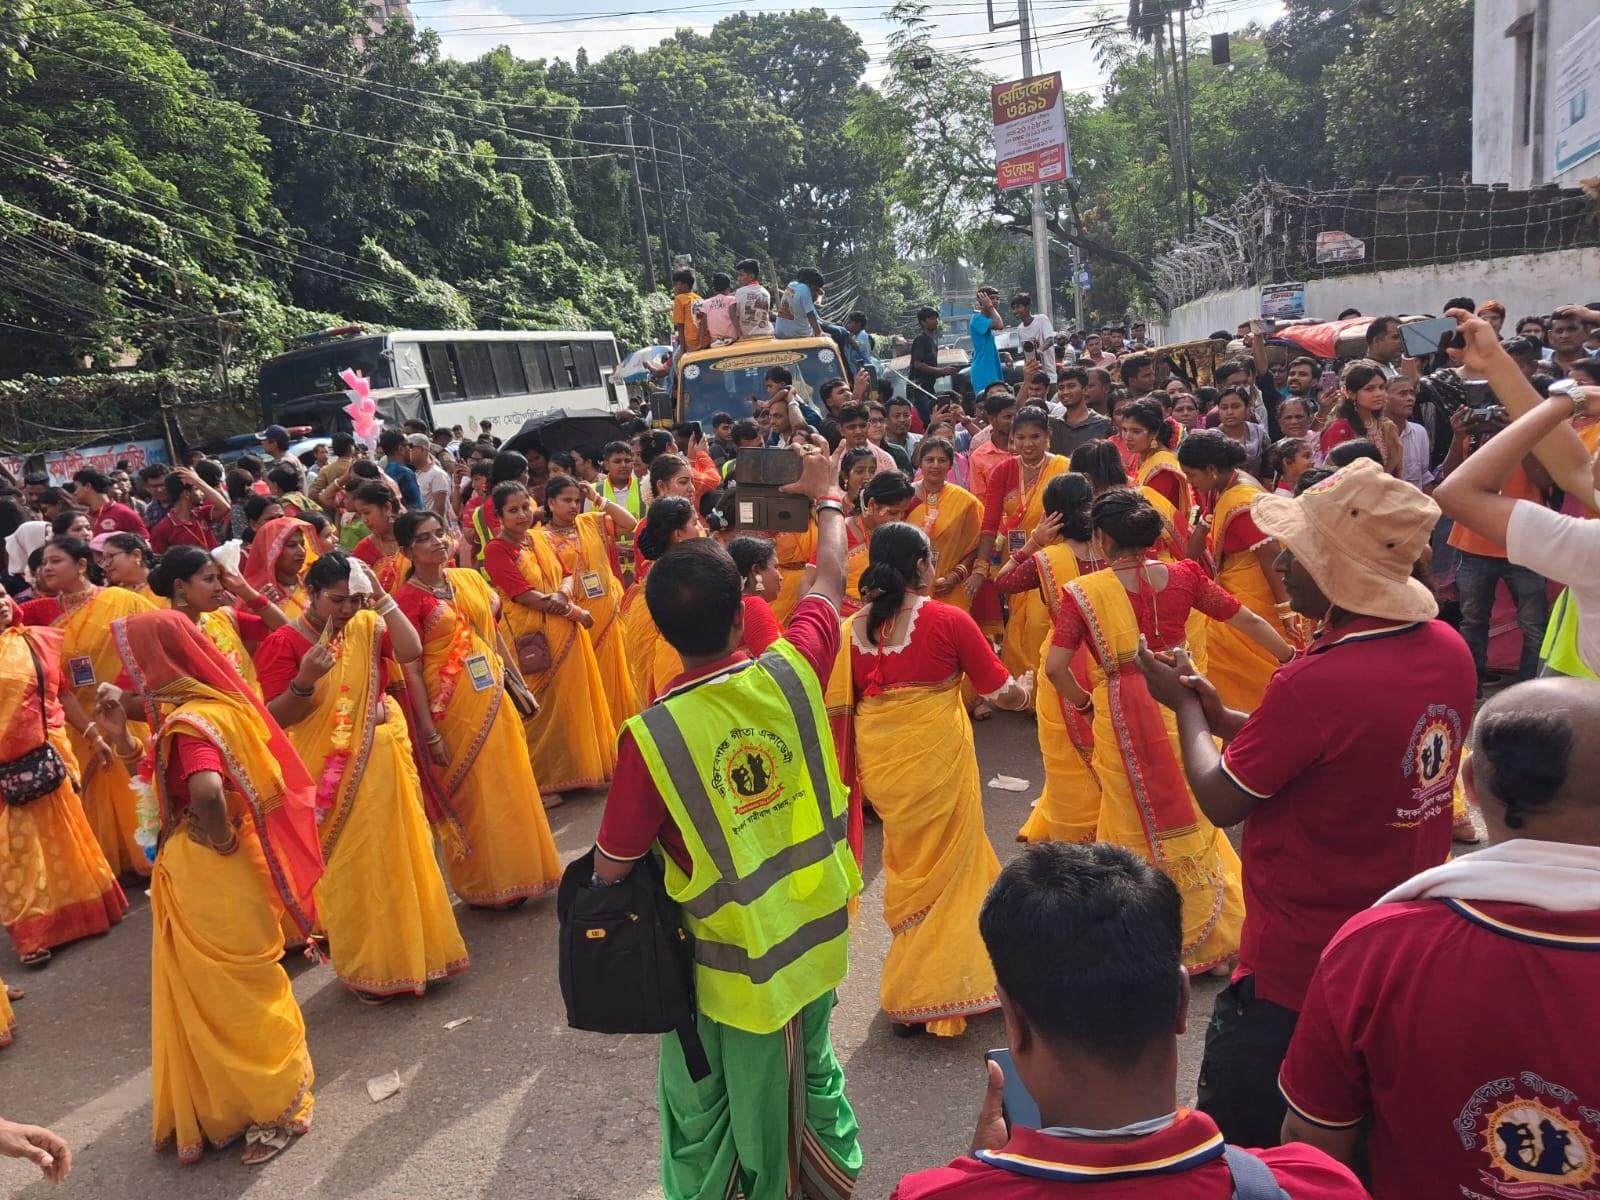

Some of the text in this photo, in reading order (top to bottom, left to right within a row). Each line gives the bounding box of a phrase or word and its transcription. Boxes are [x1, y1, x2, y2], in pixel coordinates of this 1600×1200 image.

[998, 75, 1055, 106] মেডিকেল
[1006, 96, 1046, 118] ৩৪৯১
[1002, 161, 1035, 177] উন্মেষ
[730, 728, 754, 739] গীতা
[759, 730, 793, 763] একাডেমী
[1520, 1071, 1578, 1104] গীতা
